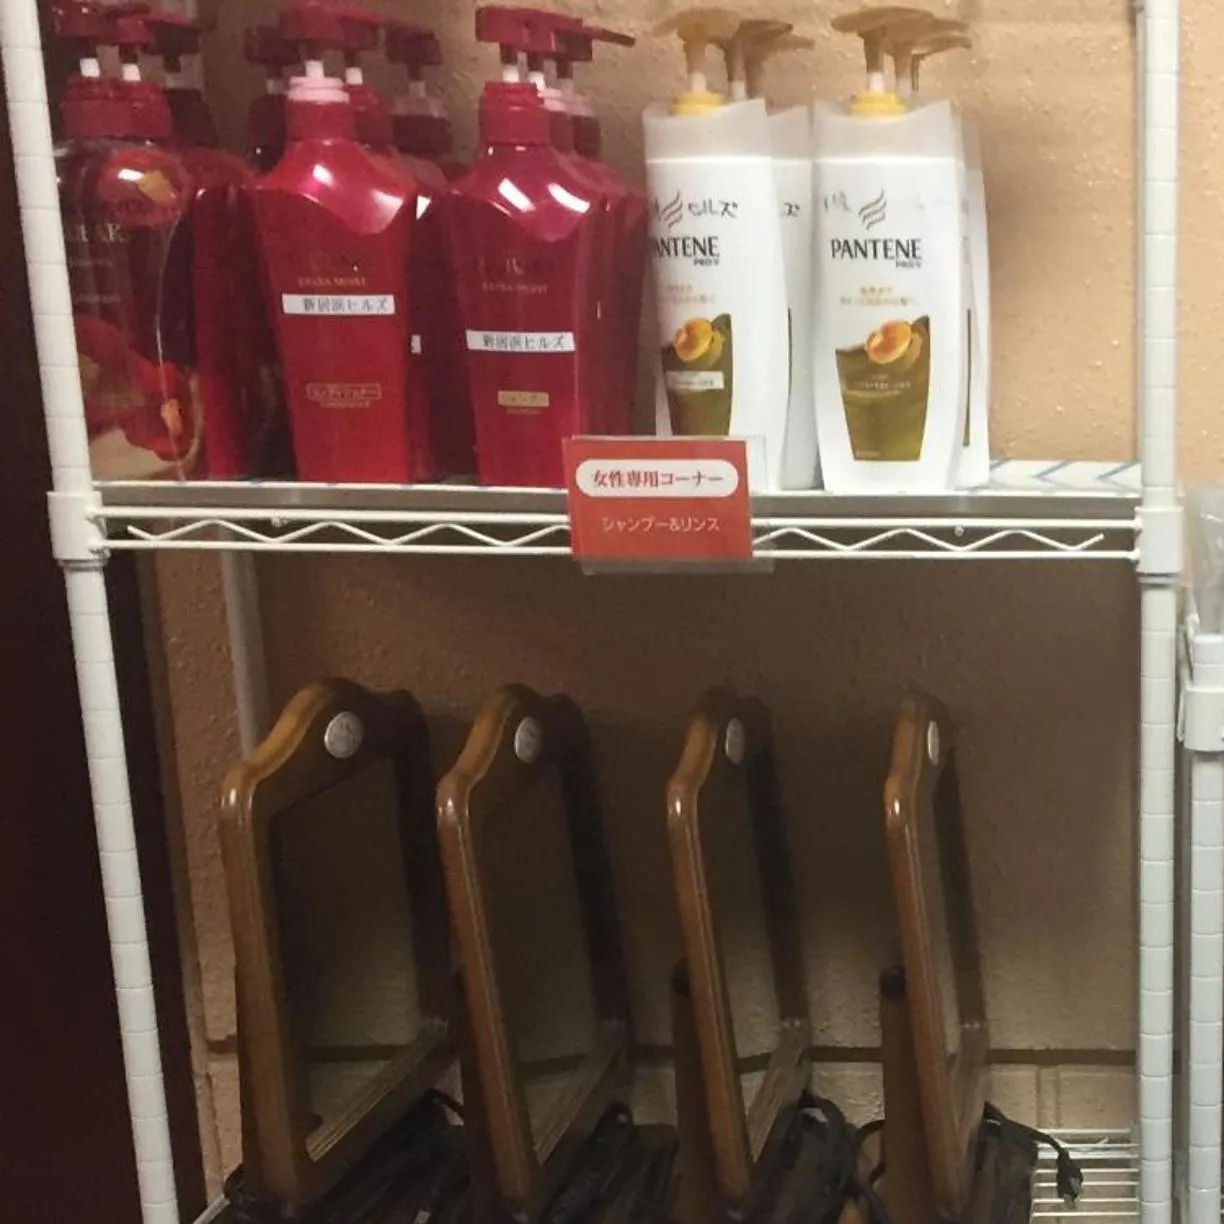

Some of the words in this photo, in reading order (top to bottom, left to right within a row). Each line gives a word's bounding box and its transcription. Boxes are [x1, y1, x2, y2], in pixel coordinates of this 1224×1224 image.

[651, 236, 720, 258] ANTENE
[831, 238, 922, 260] PANTENE
[593, 469, 724, 488] 女性専用コーナー
